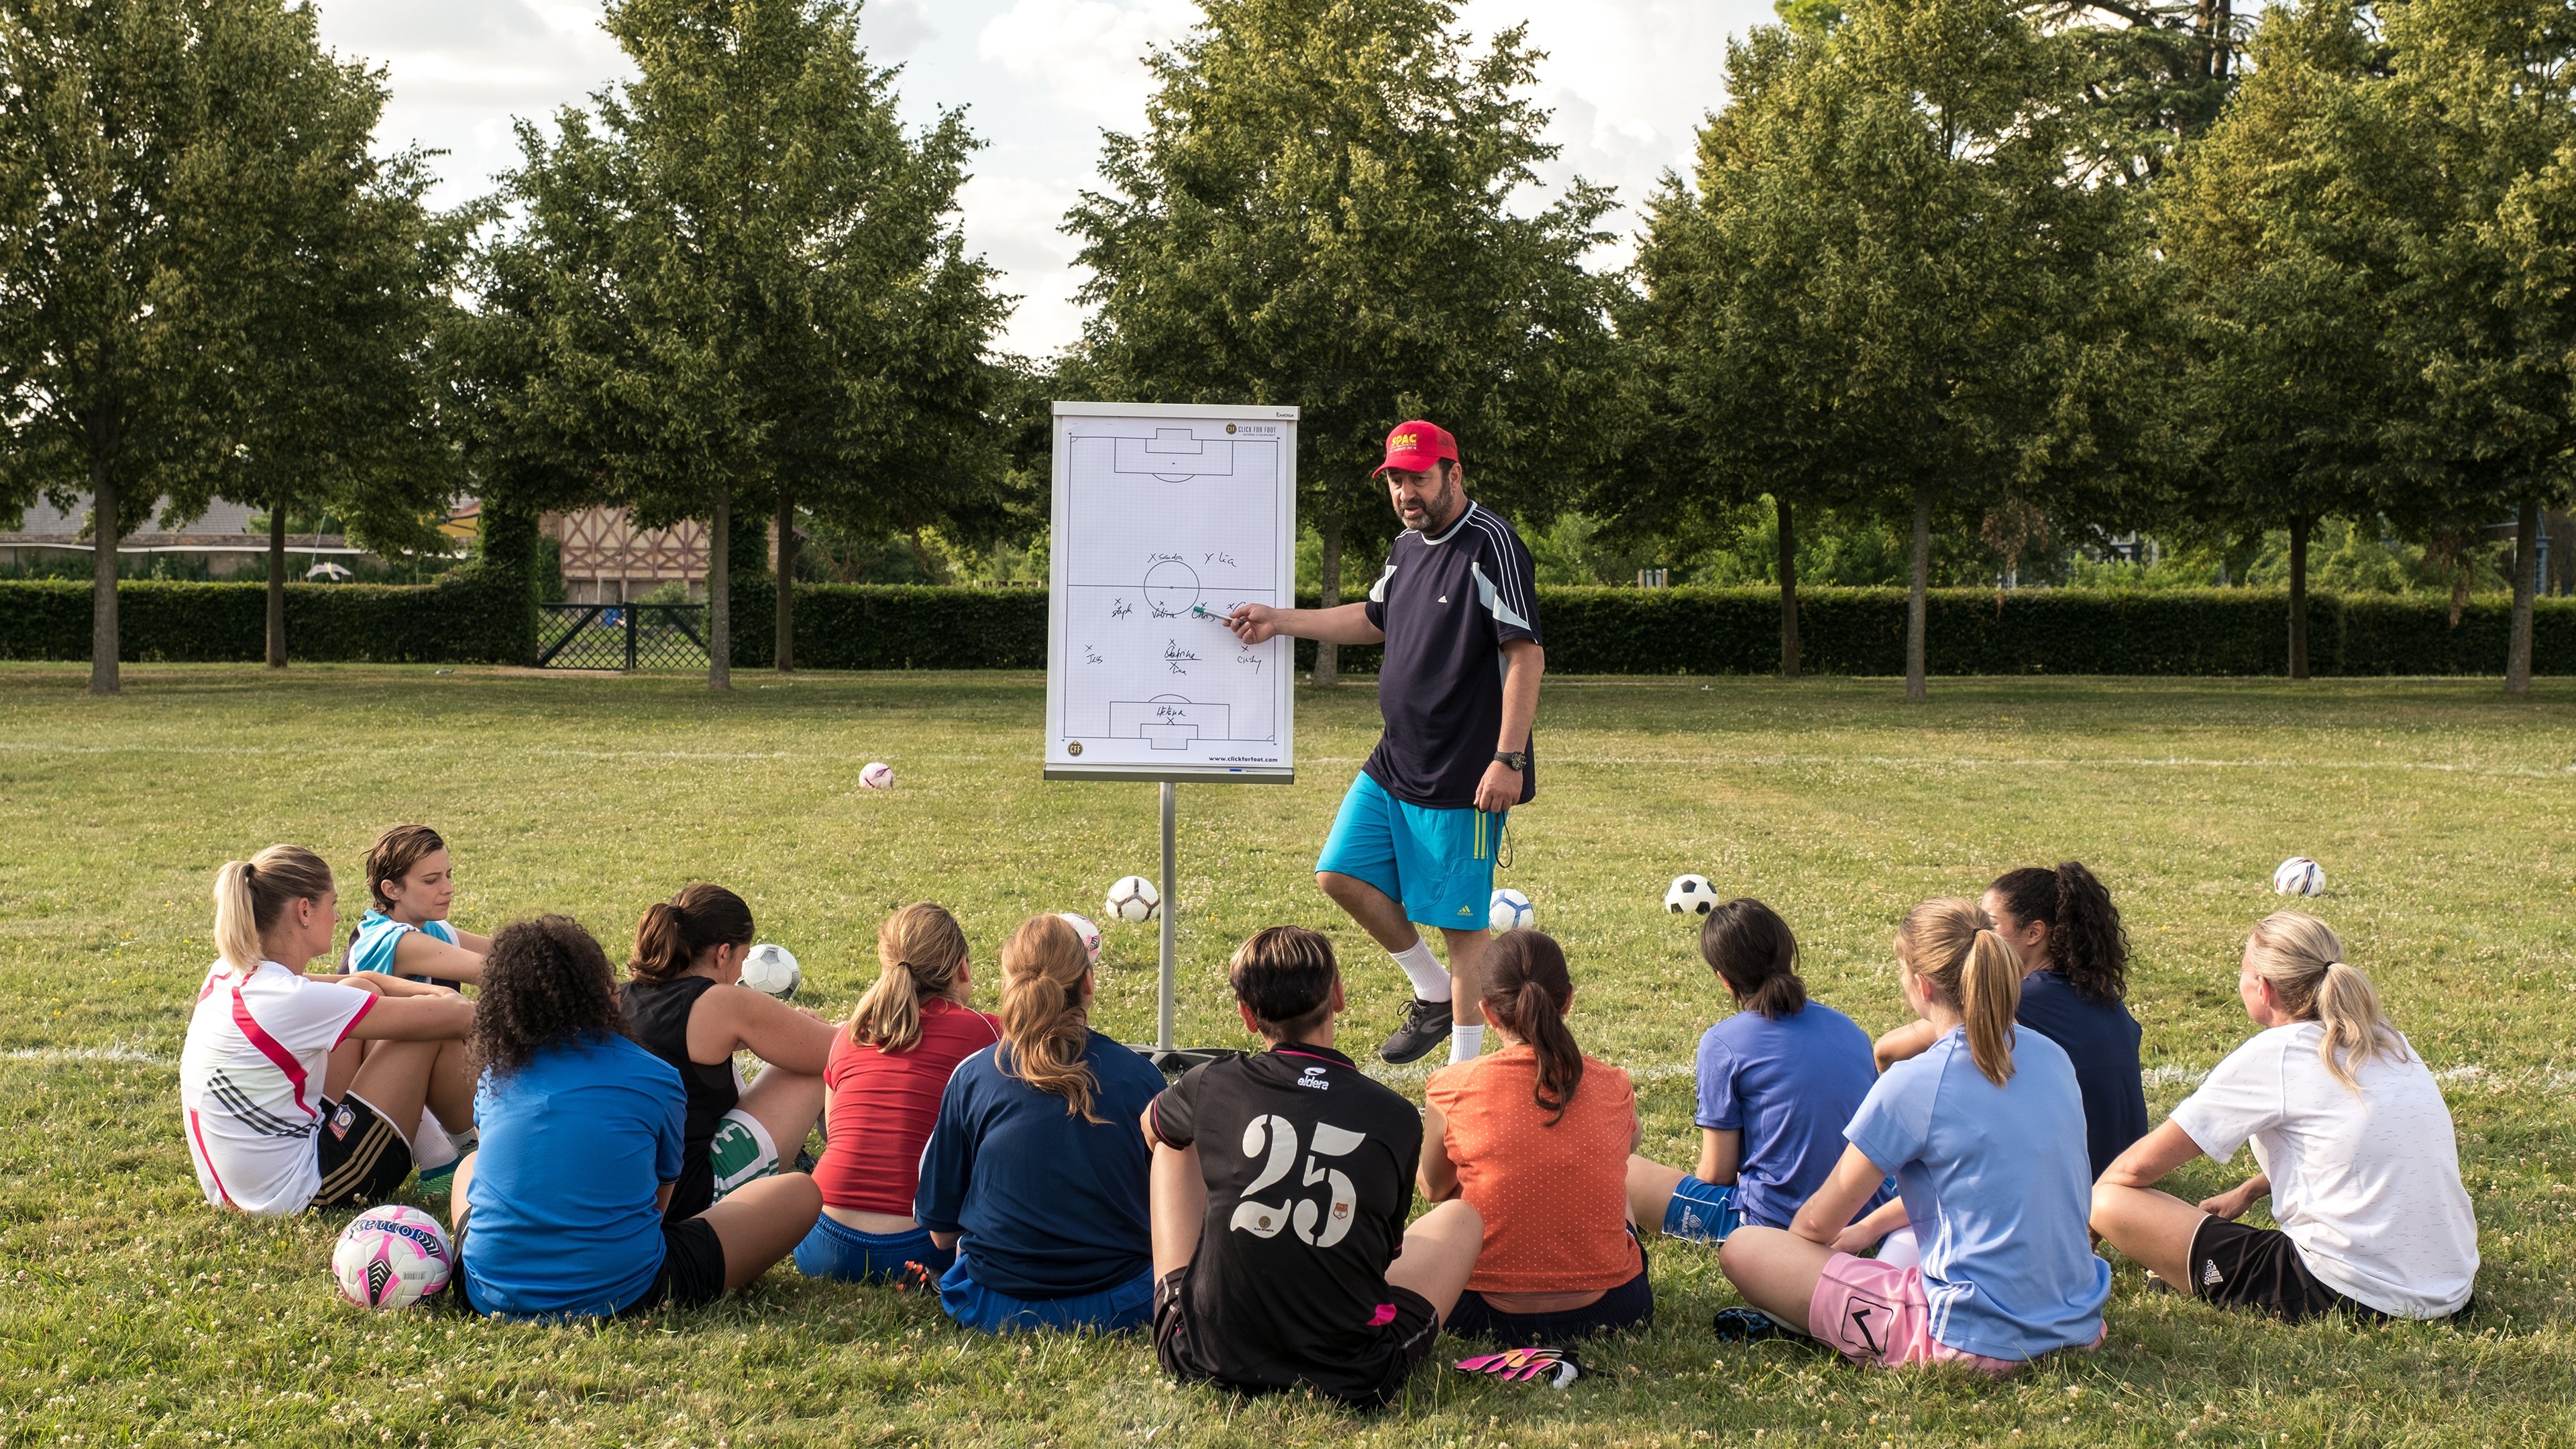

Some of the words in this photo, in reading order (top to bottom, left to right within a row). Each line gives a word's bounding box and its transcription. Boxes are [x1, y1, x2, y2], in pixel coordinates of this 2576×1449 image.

[1391, 433, 1417, 447] SPAC
[1070, 745, 1080, 753] CFF
[1297, 1075, 1329, 1090] eldera
[1230, 1114, 1366, 1248] 25
[364, 1219, 425, 1242] Joma
[2204, 1259, 2214, 1286] adidas
